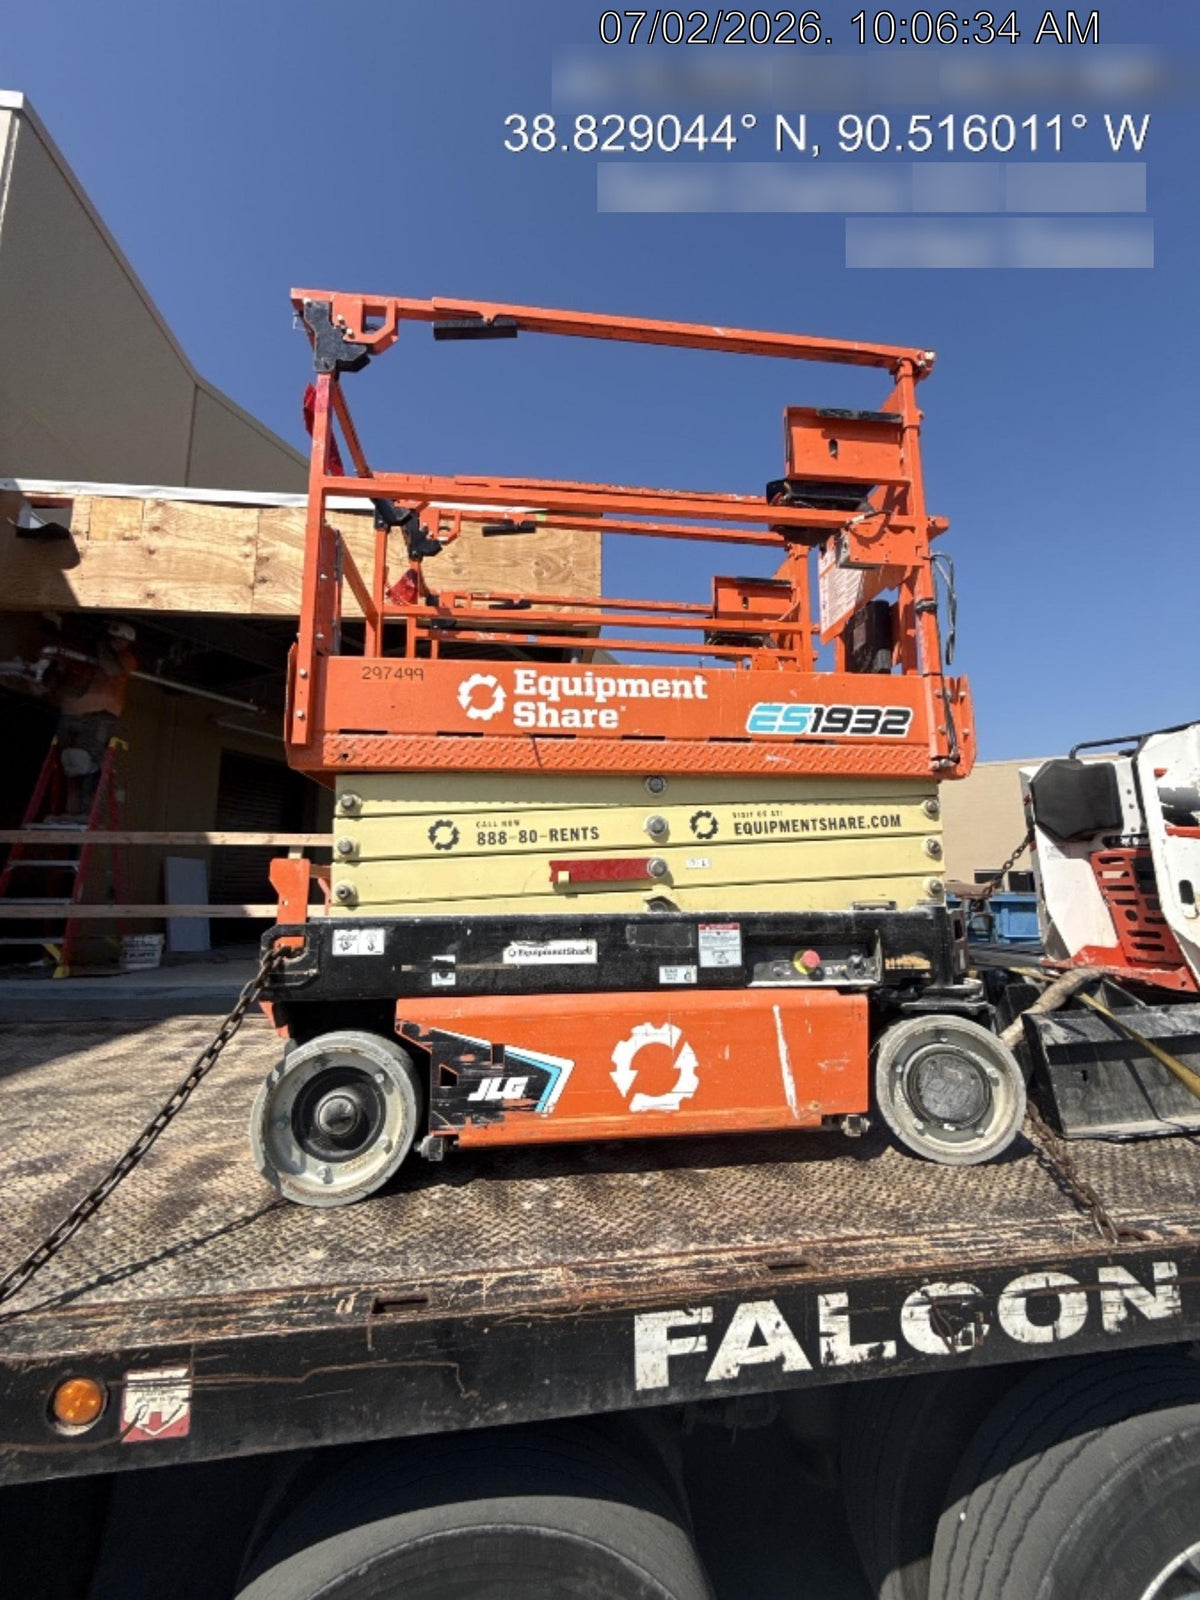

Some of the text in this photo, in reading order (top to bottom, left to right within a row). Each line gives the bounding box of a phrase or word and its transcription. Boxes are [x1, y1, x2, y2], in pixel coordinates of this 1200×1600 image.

[361, 666, 424, 681] 297499
[513, 669, 708, 702] Equipment
[513, 701, 619, 729] Share
[747, 703, 913, 738] ES1932
[477, 826, 600, 846] 888-80-RENTS
[733, 814, 902, 836] EQUIPMENTSHARE.COM
[467, 1077, 529, 1101] JLG
[634, 1262, 1182, 1391] FALCON
